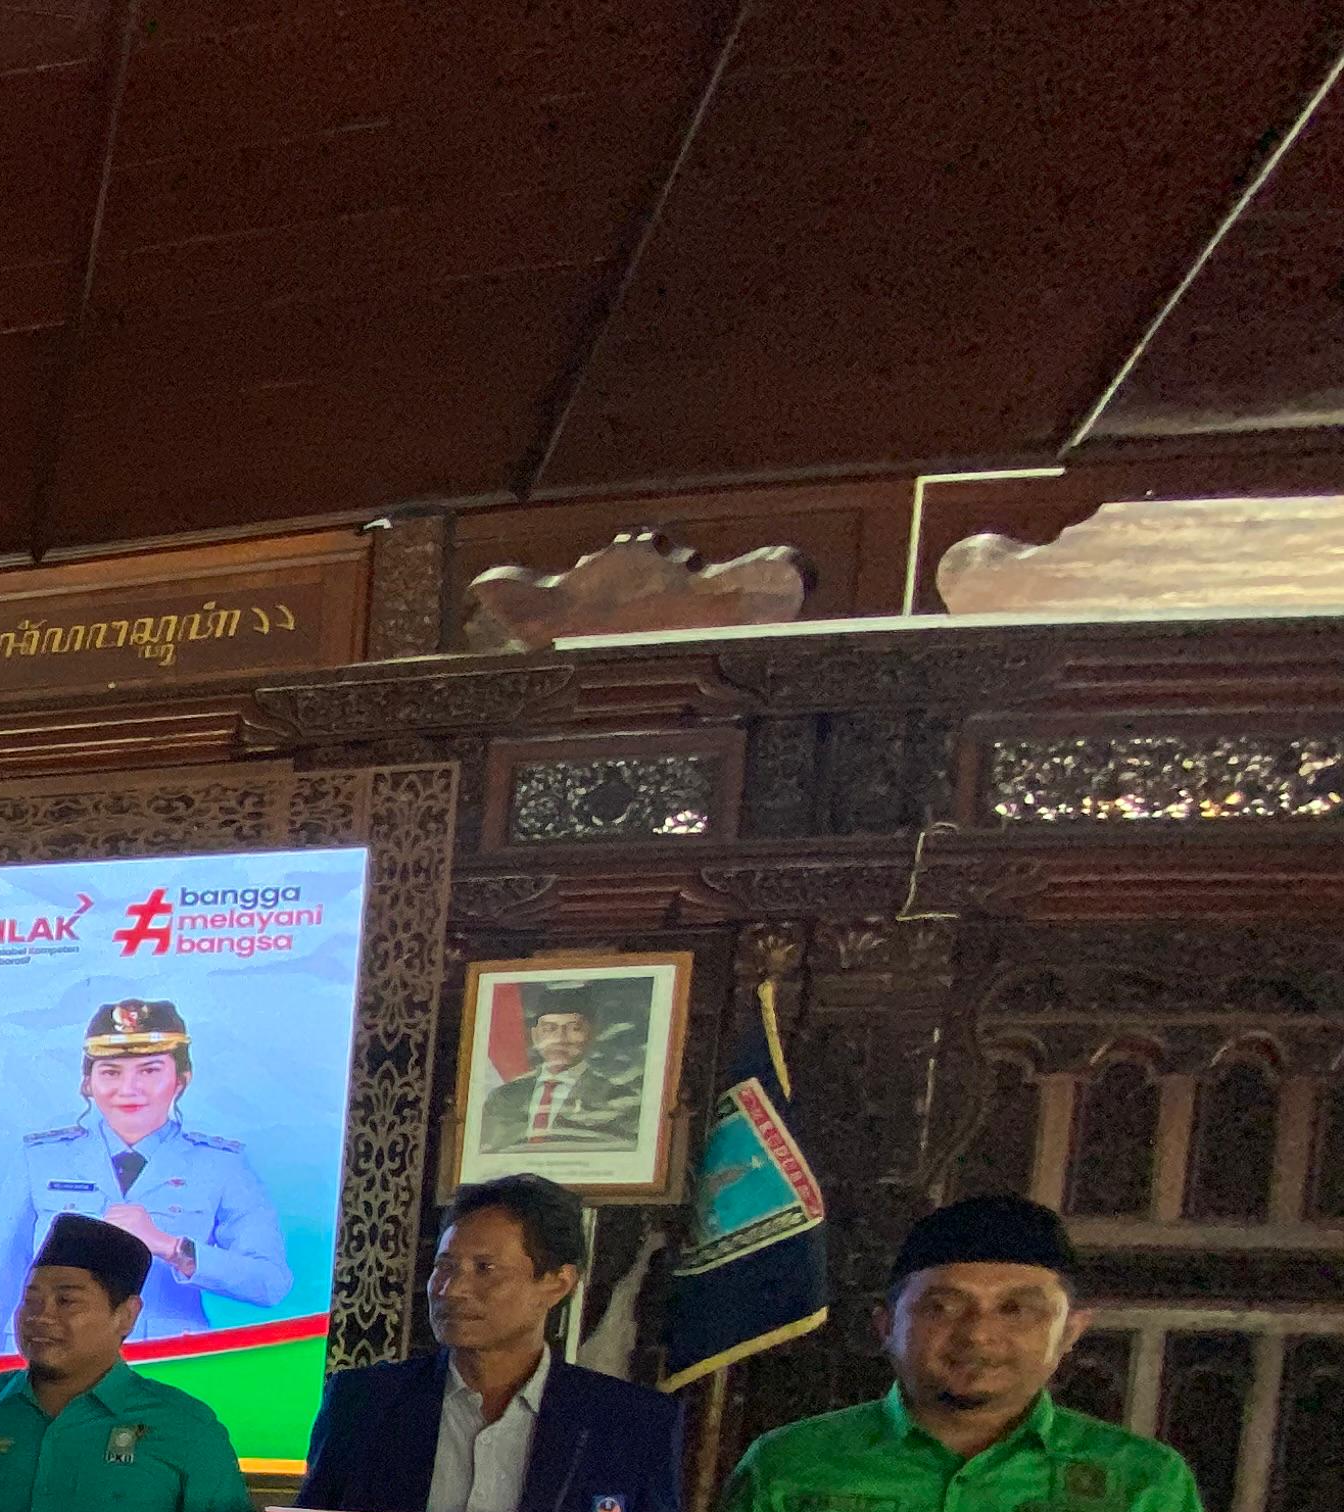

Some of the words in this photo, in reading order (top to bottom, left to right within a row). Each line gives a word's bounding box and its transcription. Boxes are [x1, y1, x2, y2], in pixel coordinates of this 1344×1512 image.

[180, 886, 301, 910] bangga
[178, 904, 323, 933] melayani
[176, 934, 293, 958] bangsa
